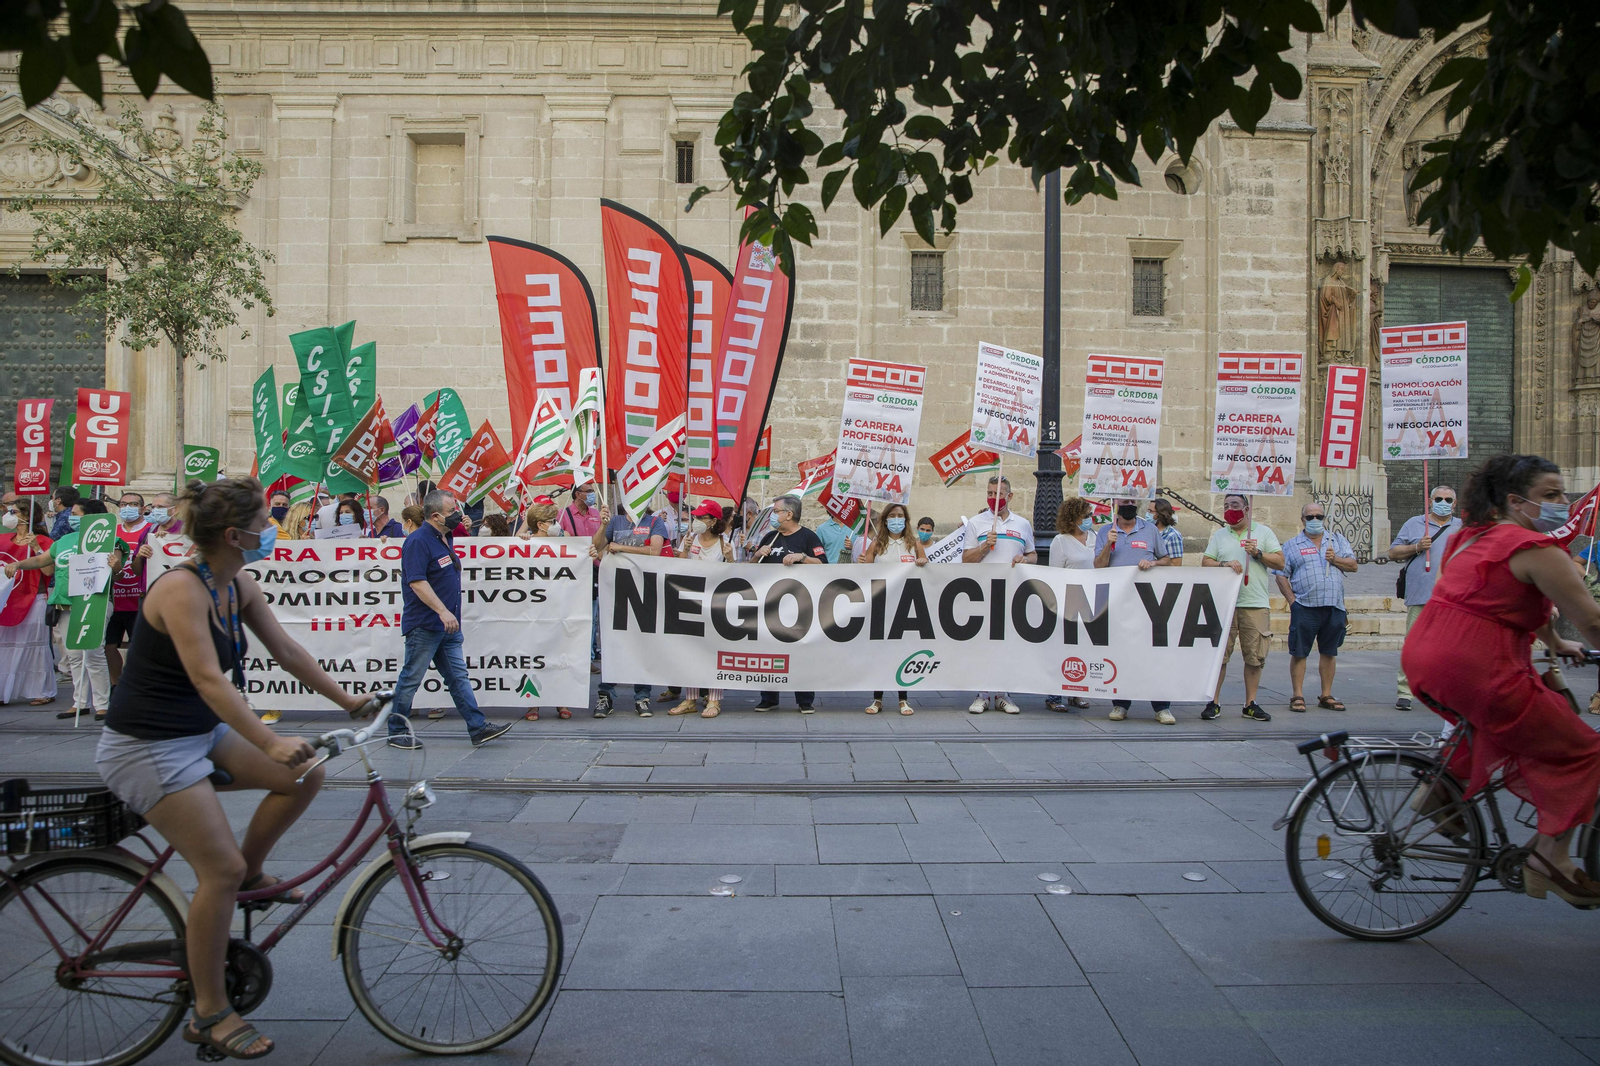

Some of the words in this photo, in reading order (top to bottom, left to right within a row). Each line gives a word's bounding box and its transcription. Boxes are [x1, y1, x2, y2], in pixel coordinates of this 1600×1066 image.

[1382, 328, 1465, 348] CCOO
[1006, 352, 1040, 367] CÓRDOBA
[1218, 357, 1301, 374] CCOO
[1416, 354, 1462, 364] CÓRDOBA
[848, 364, 924, 387] CCOO
[984, 362, 1014, 374] PROMOCIÓN
[1087, 360, 1162, 381] CCOO
[983, 377, 1016, 390] DESARROLLO
[988, 370, 1030, 385] ADMINISTRATIVO
[1392, 378, 1462, 389] HOMOLOGACIÓN
[1118, 388, 1158, 400] CÓRDOBA
[1251, 385, 1296, 394] CÓRDOBA
[877, 394, 918, 406] CÓRDOBA
[981, 392, 1010, 404] SOLUCIONES
[1011, 400, 1034, 411] PERSONAL
[984, 408, 1036, 427] NEGOCIACIÓN
[1093, 414, 1156, 424] HOMOLOGACIÓN
[1229, 413, 1282, 423] CARRERA
[1326, 368, 1358, 467] CCOO
[1397, 418, 1462, 429] NEGOCIACIÓN
[86, 393, 120, 458] UGT
[844, 418, 852, 426] #
[854, 419, 903, 433] CARRERA
[1092, 423, 1129, 432] SALARIAL
[1217, 425, 1295, 436] PROFESIONAL
[23, 403, 46, 468] UGT
[843, 430, 914, 446] PROFESIONAL
[1007, 424, 1029, 446] YA
[1426, 430, 1457, 448] YA
[850, 459, 909, 473] NEGOCIACIÓN
[1094, 458, 1153, 467] NEGOCIACIÓN
[1226, 454, 1291, 463] NEGOCIACIÓN
[876, 472, 902, 493] YA
[1121, 468, 1148, 488] YA
[1256, 465, 1285, 485] YA
[336, 544, 577, 561] PROSIONAL
[463, 566, 577, 580] TERNA
[612, 567, 1110, 648] NEGOCIACION
[1134, 582, 1223, 648] YA
[366, 658, 398, 672] DE
[721, 654, 772, 669] CCOO
[1064, 660, 1084, 672] UGT
[1090, 663, 1105, 671] FSP
[716, 671, 742, 682] área
[745, 672, 788, 684] pública
